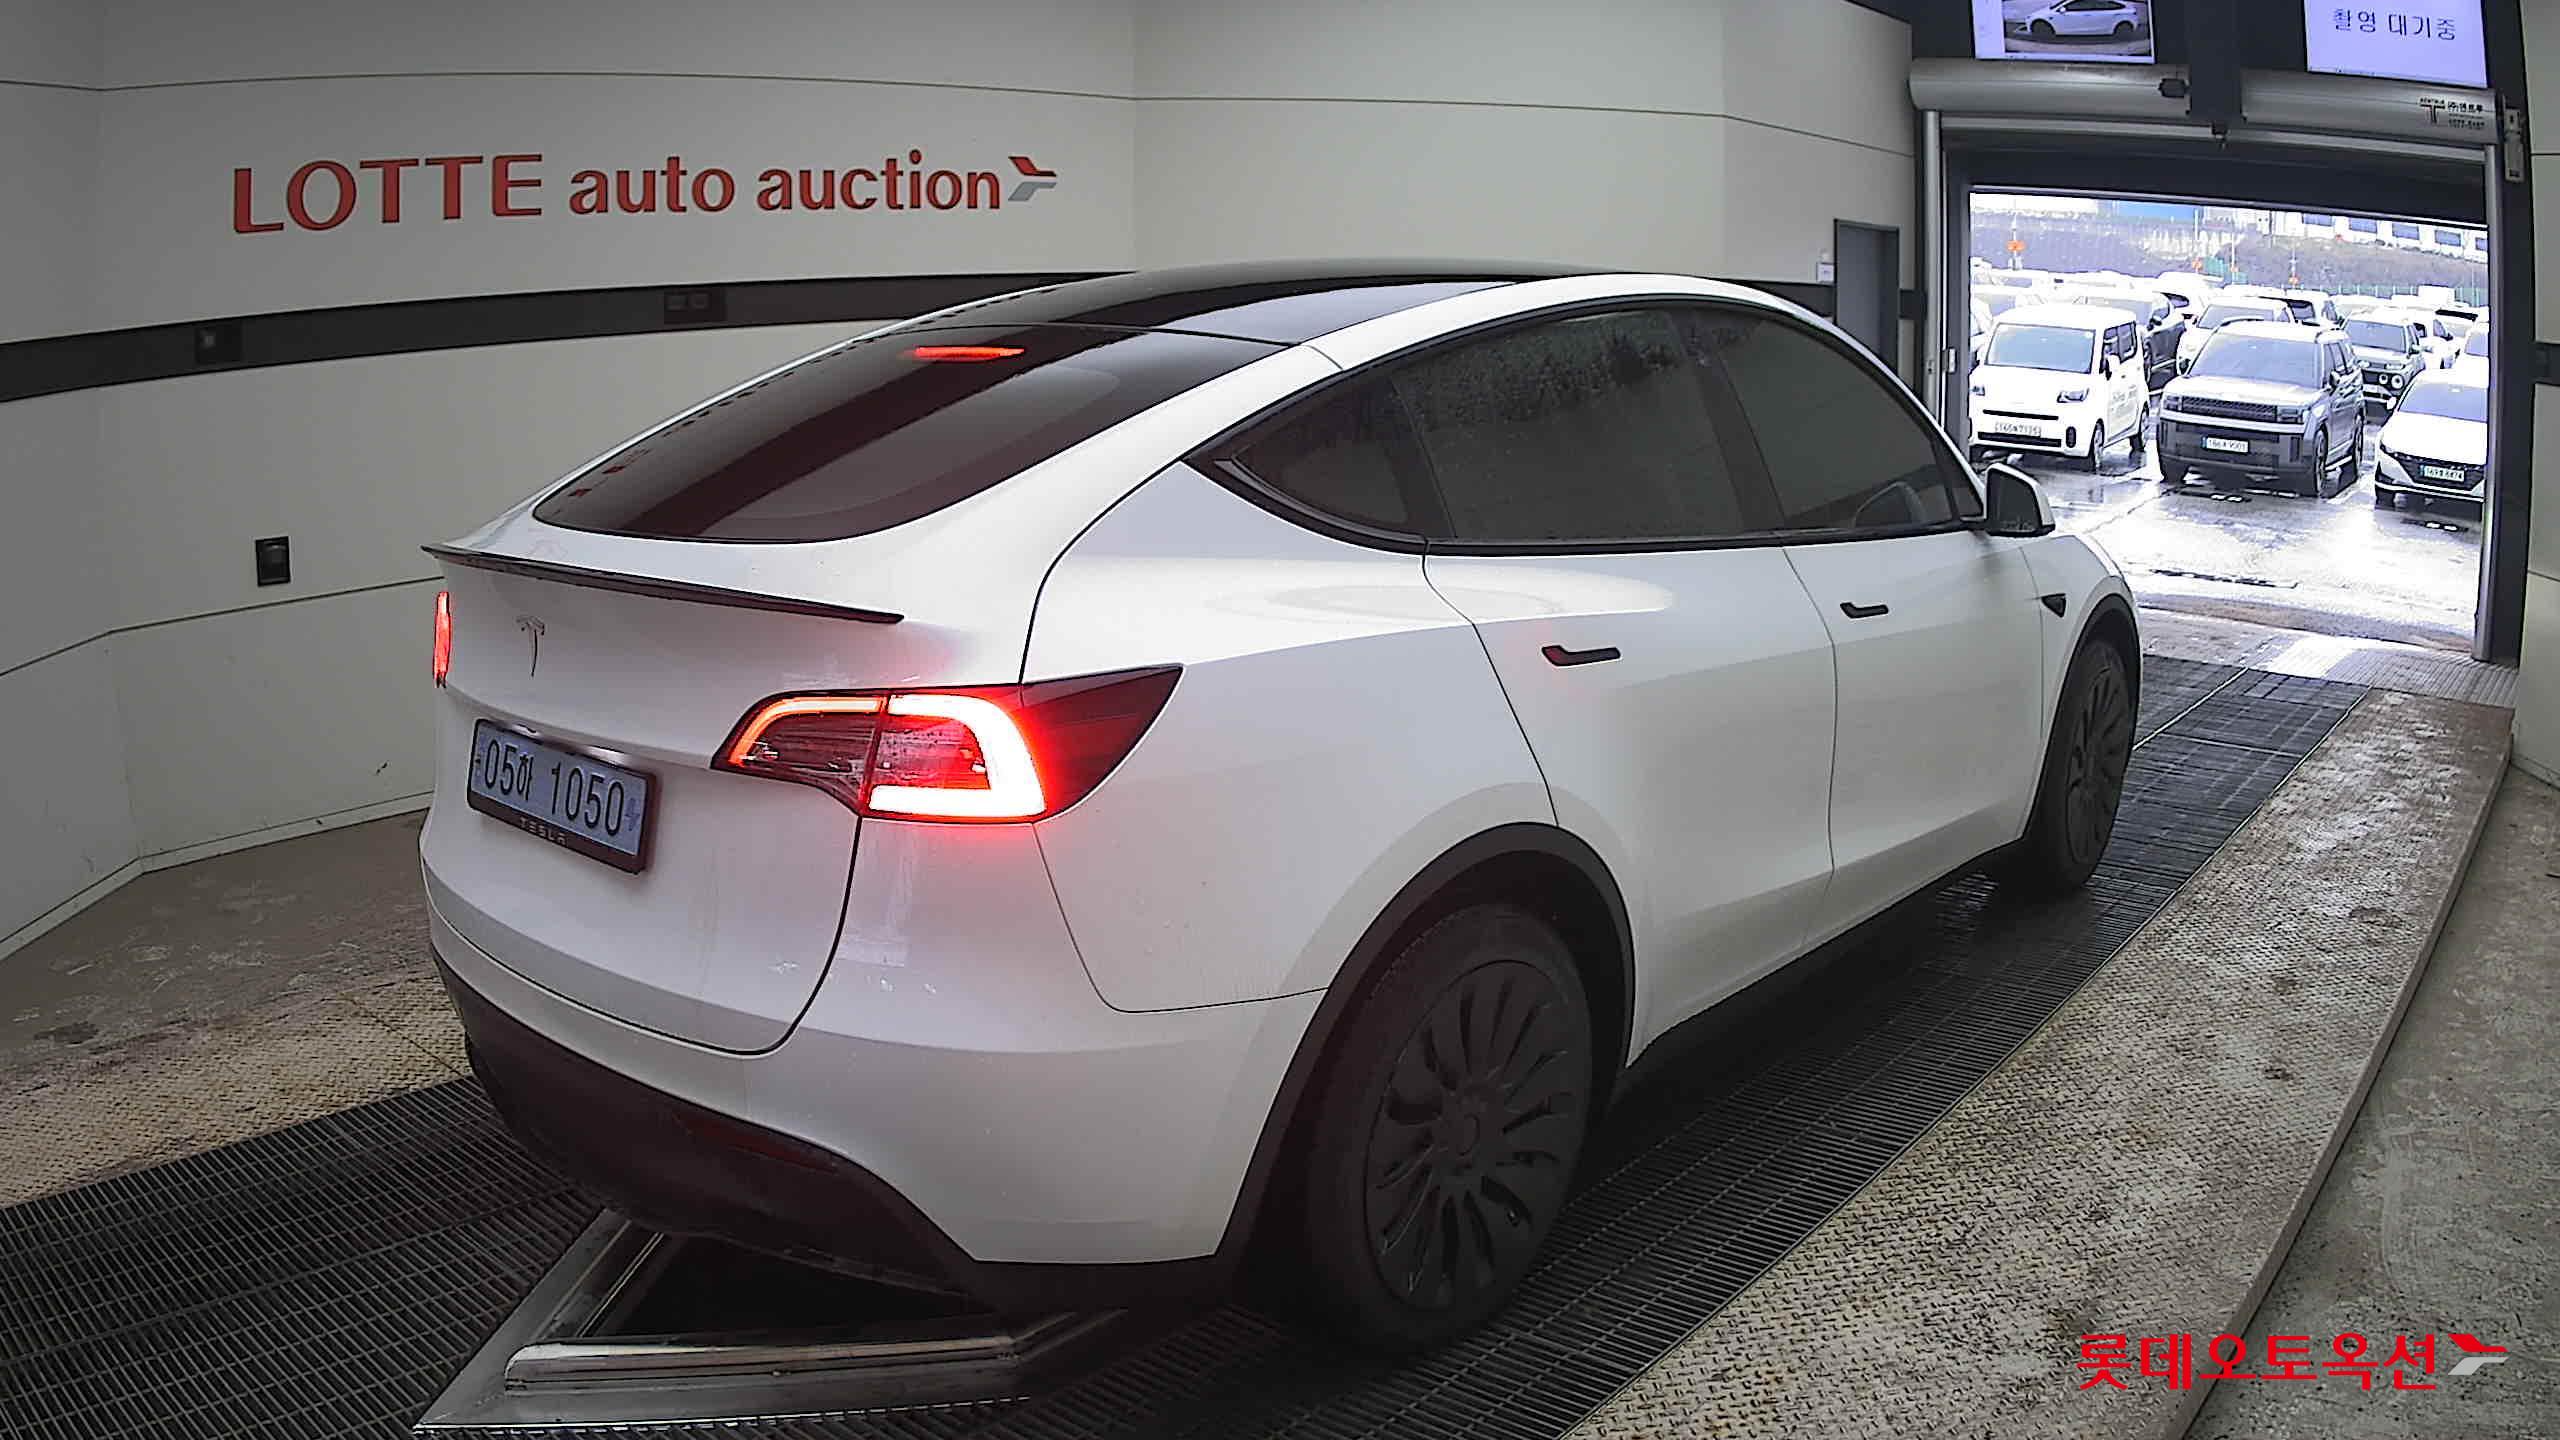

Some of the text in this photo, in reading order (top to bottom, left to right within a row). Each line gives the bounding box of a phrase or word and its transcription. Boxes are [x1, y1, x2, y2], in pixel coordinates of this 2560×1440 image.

[2333, 8, 2457, 41] 촬영 대기중
[233, 149, 1001, 234] LOTTE auto auction
[484, 738, 625, 837] 05하 1050
[519, 816, 568, 847] TESLA
